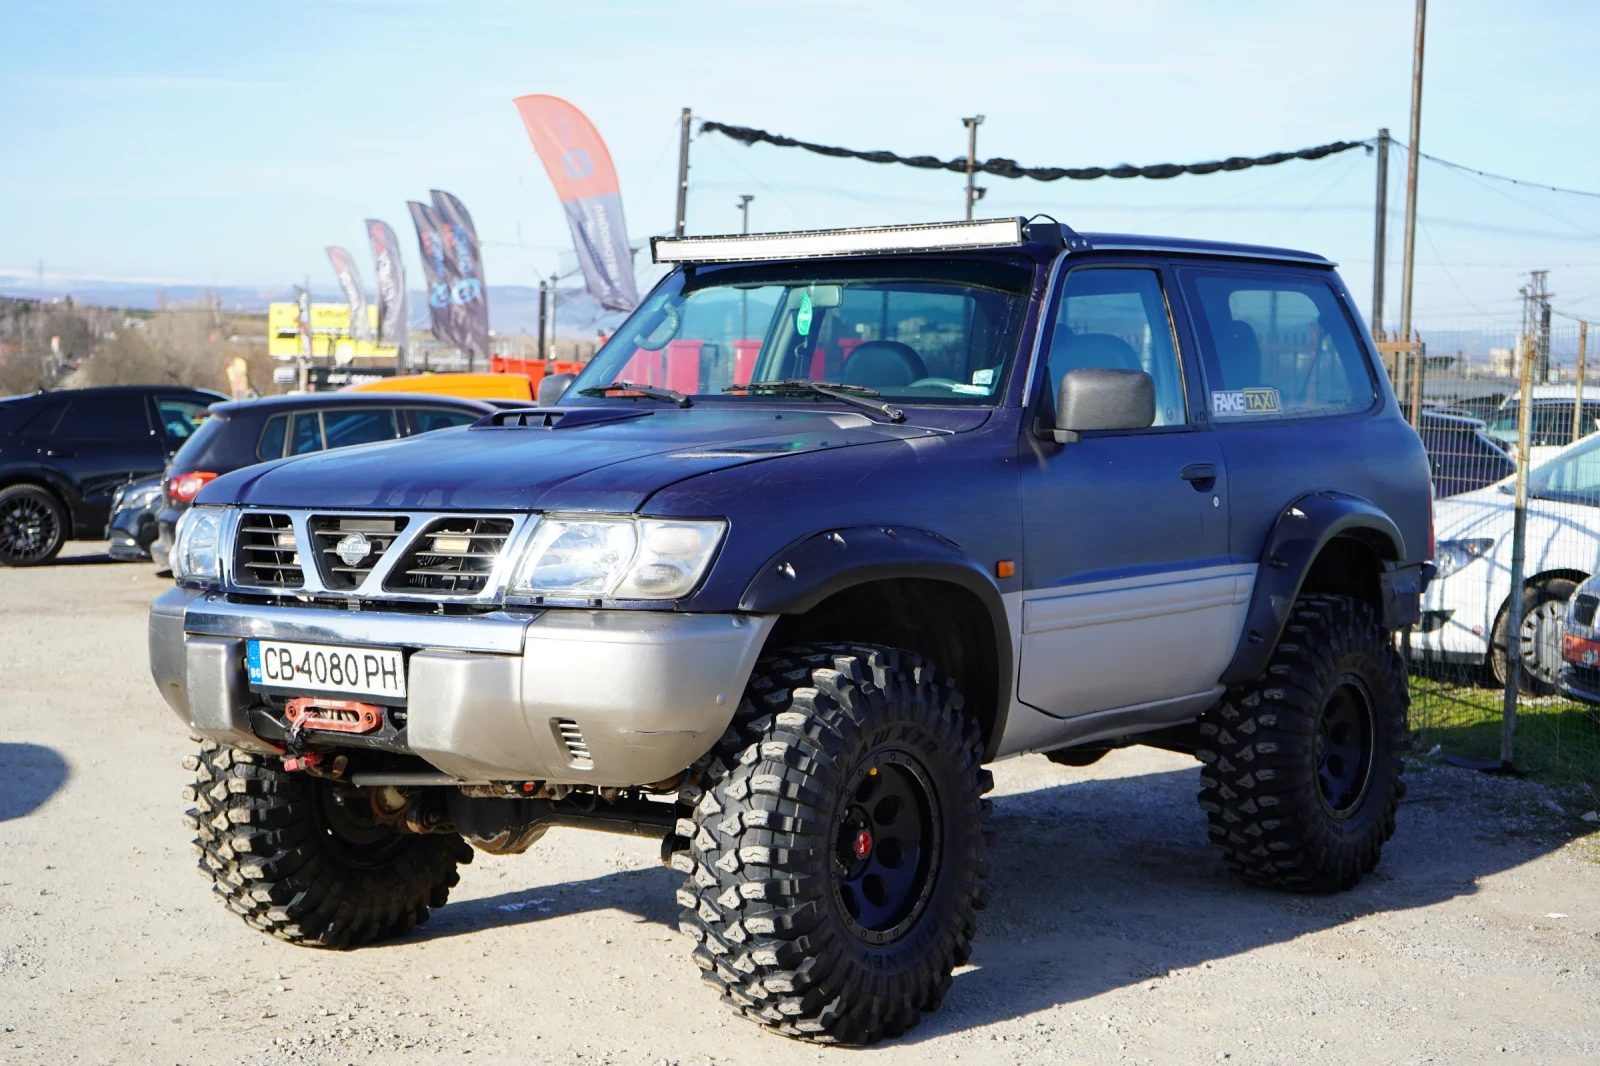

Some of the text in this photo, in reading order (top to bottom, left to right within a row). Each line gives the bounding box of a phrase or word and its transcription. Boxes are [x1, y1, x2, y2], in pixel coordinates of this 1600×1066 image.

[1213, 392, 1245, 412] FAKE
[1246, 391, 1275, 411] TAXI
[250, 668, 262, 679] BG
[300, 650, 359, 686] 4080
